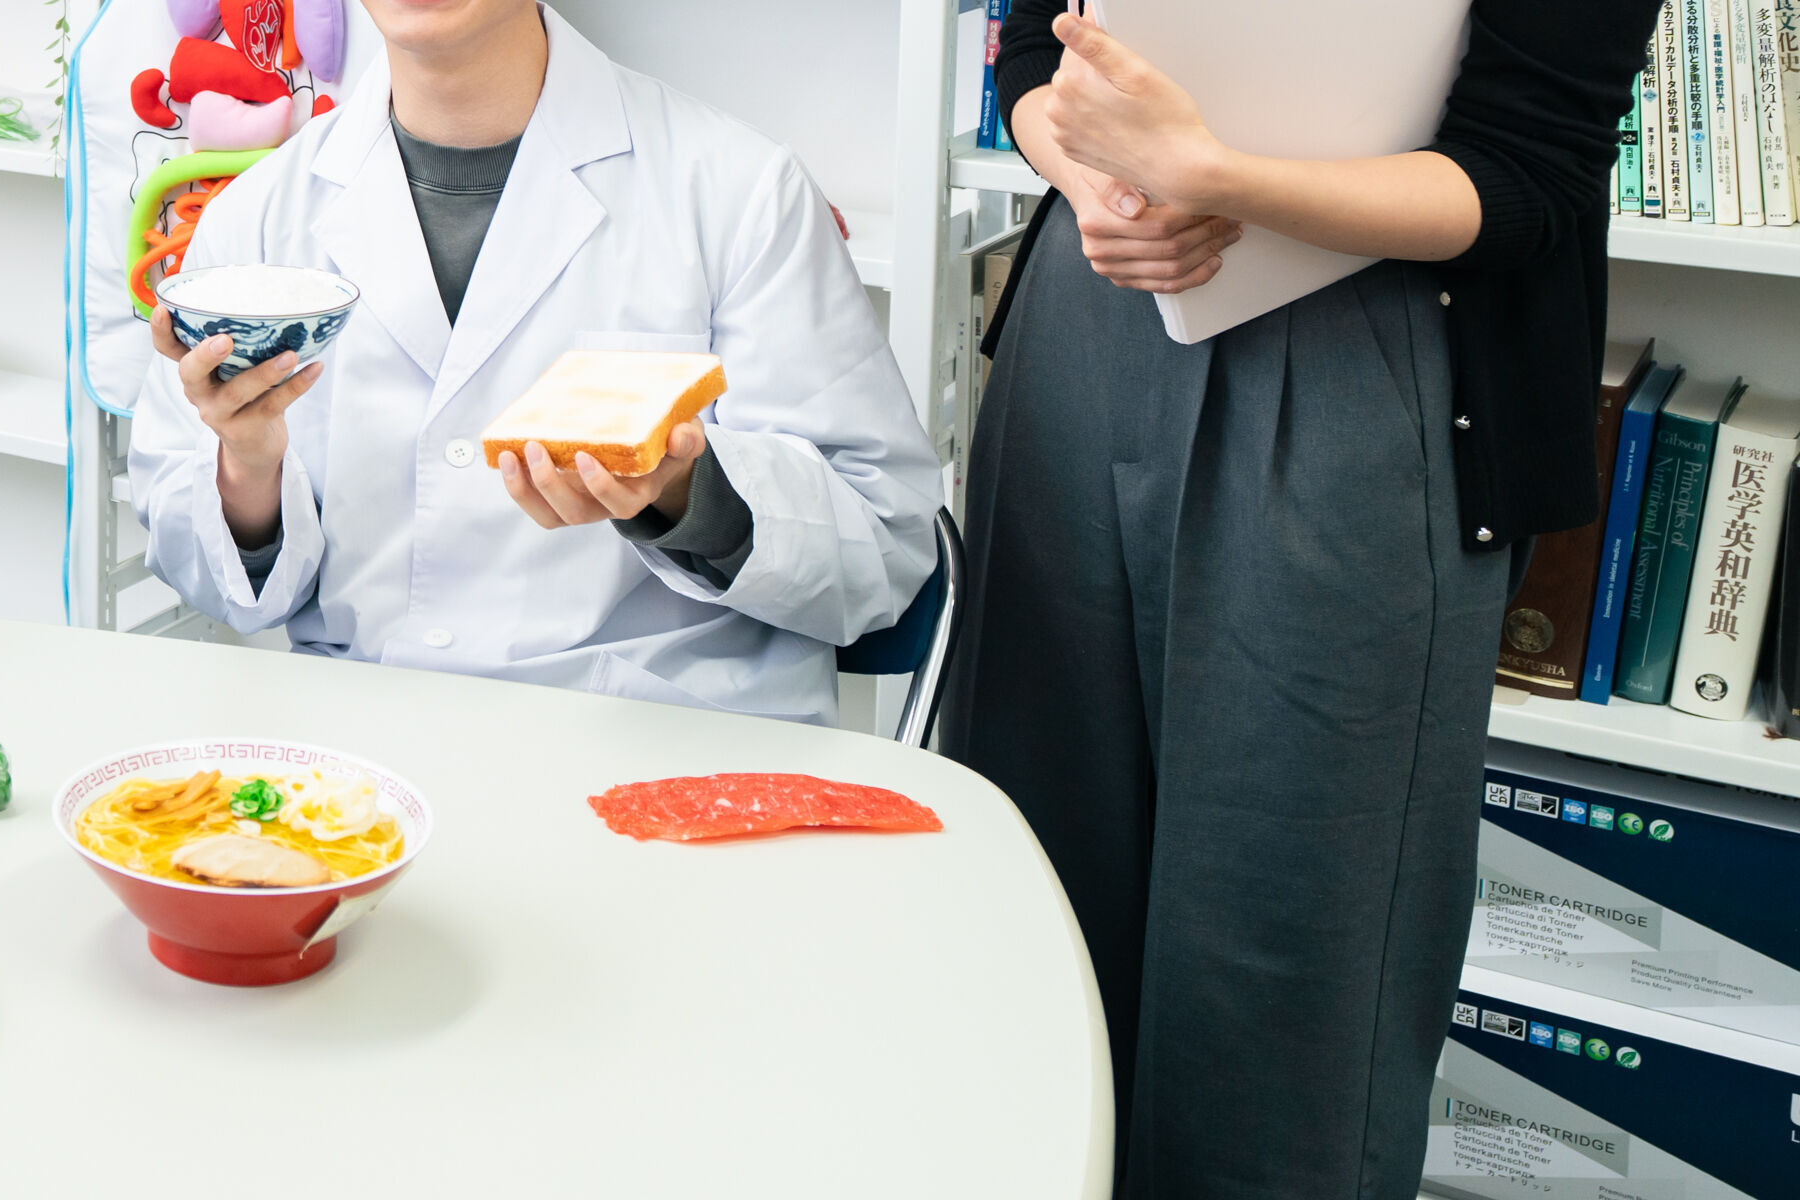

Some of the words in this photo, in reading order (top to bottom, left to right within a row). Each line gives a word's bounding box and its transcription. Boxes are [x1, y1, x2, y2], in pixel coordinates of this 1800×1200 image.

[1755, 7, 1776, 134] 多変量解析のはなし
[1657, 429, 1706, 454] Gibson
[1732, 444, 1775, 464] 研究社
[1640, 454, 1674, 536] Nutritional
[1674, 459, 1703, 530] Principles
[1612, 538, 1622, 561] medicine
[1669, 529, 1689, 552] of
[1703, 459, 1769, 642] 医学英和辞典
[1609, 562, 1619, 583] skeletal
[1628, 536, 1659, 620] Assessment
[1603, 590, 1614, 619] Innovation
[1487, 794, 1508, 805] CA
[1489, 784, 1509, 796] UK
[1564, 803, 1585, 816] ISO
[1591, 809, 1614, 822] ISO
[1620, 815, 1641, 830] CE
[1487, 891, 1540, 912] Cartuchos
[1541, 904, 1554, 915] de
[1487, 901, 1535, 921] Cartuccia
[1536, 912, 1547, 923] di
[1549, 915, 1578, 931] Toner
[1489, 880, 1545, 904] TONER
[1549, 895, 1649, 928] CARTRIDGE
[1486, 920, 1564, 947] Tonerkartusche
[1487, 911, 1538, 932] Cartouche
[1540, 923, 1552, 934] de
[1554, 926, 1585, 942] Toner
[1486, 940, 1586, 969] トナーカートリッジ
[1630, 968, 1662, 983] Product
[1662, 976, 1692, 991] Quality
[1693, 984, 1742, 1000] Guaranteed
[1630, 976, 1650, 988] Save
[1651, 982, 1673, 993] More
[1631, 959, 1667, 975] Premium
[1668, 968, 1700, 984] Printing
[1700, 977, 1754, 995] Performance
[1455, 1014, 1475, 1026] CA
[1456, 1005, 1475, 1017] UK
[1531, 1027, 1552, 1039] ISO
[1558, 1034, 1581, 1047] ISO
[1587, 1043, 1608, 1057] CE
[1454, 1112, 1507, 1134] Cartuchos
[1509, 1126, 1522, 1138] de
[1454, 1122, 1502, 1143] Cartuccia
[1504, 1135, 1515, 1146] di
[1516, 1138, 1545, 1154] Toner
[1456, 1100, 1513, 1126] TONER
[1516, 1117, 1616, 1155] CARTRIDGE
[1453, 1131, 1505, 1154] Cartouche
[1507, 1146, 1520, 1158] de
[1521, 1150, 1552, 1166] Toner
[1453, 1141, 1532, 1170] Tonerkartusche
[1453, 1159, 1552, 1194] トナーカートリッジ
